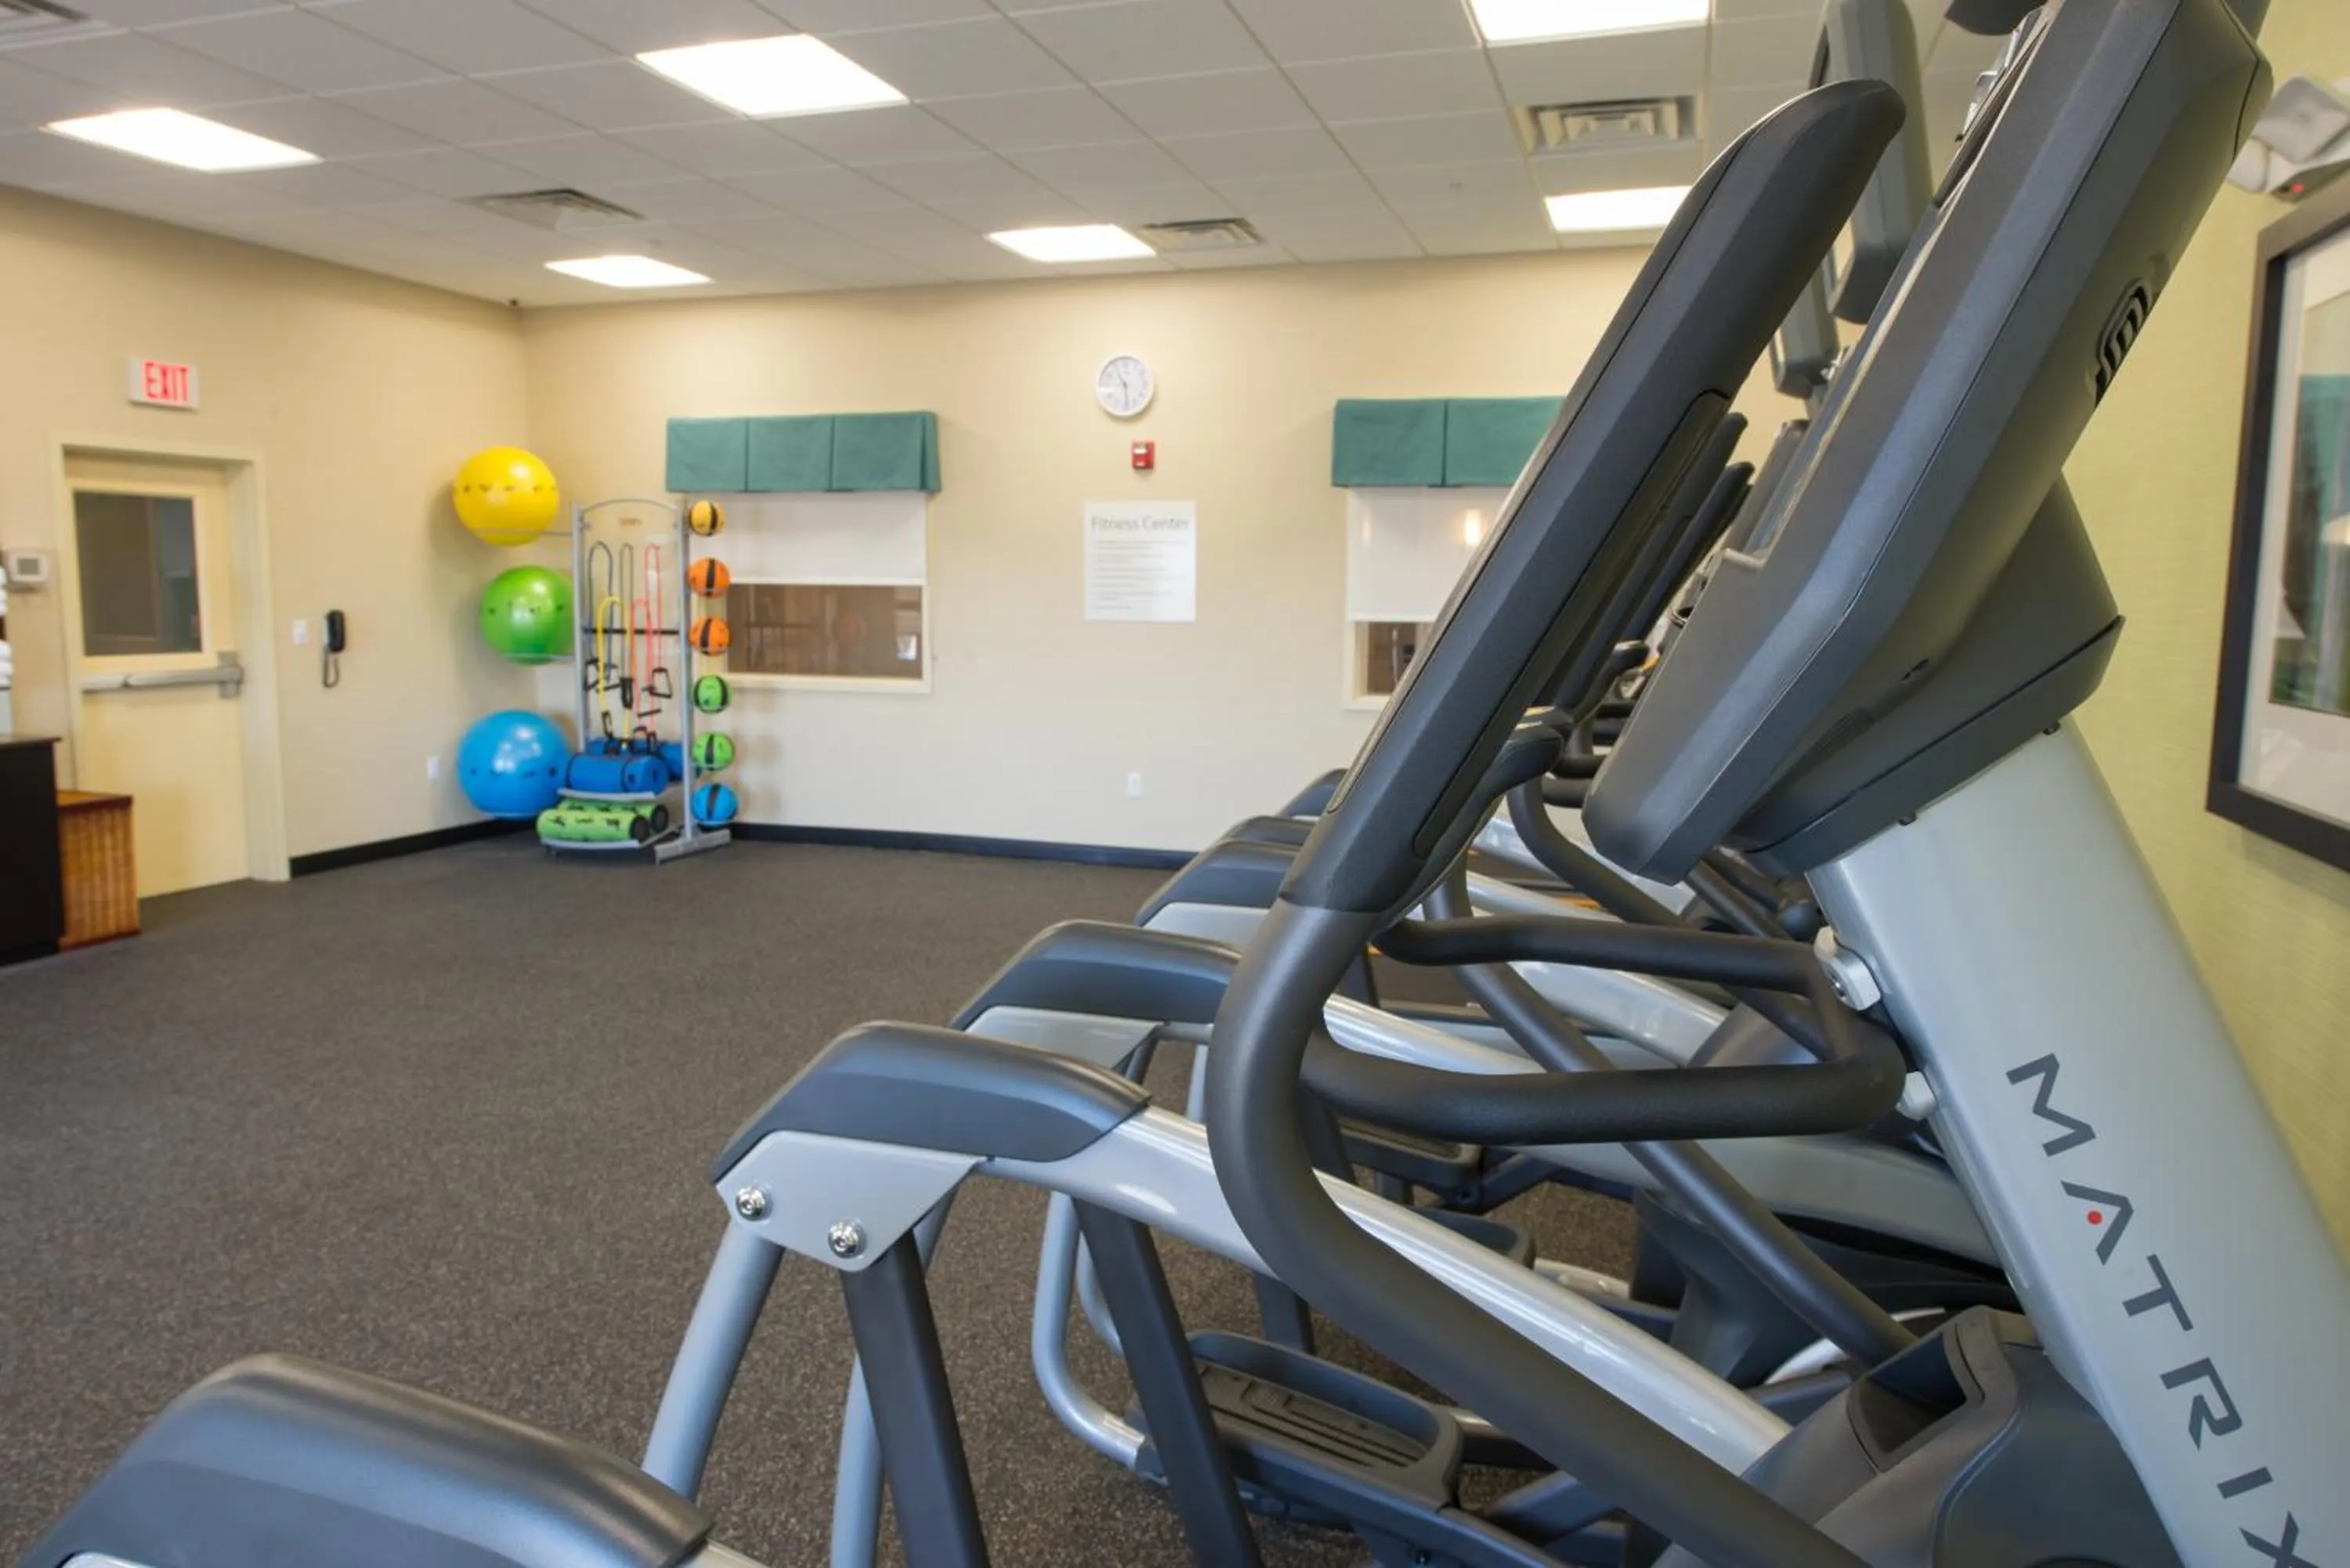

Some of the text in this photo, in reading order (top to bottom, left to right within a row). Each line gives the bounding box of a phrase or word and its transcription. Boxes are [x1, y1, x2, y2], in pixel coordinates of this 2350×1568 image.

[144, 361, 189, 402] EXIT
[1091, 515, 1191, 531] Fitness Center
